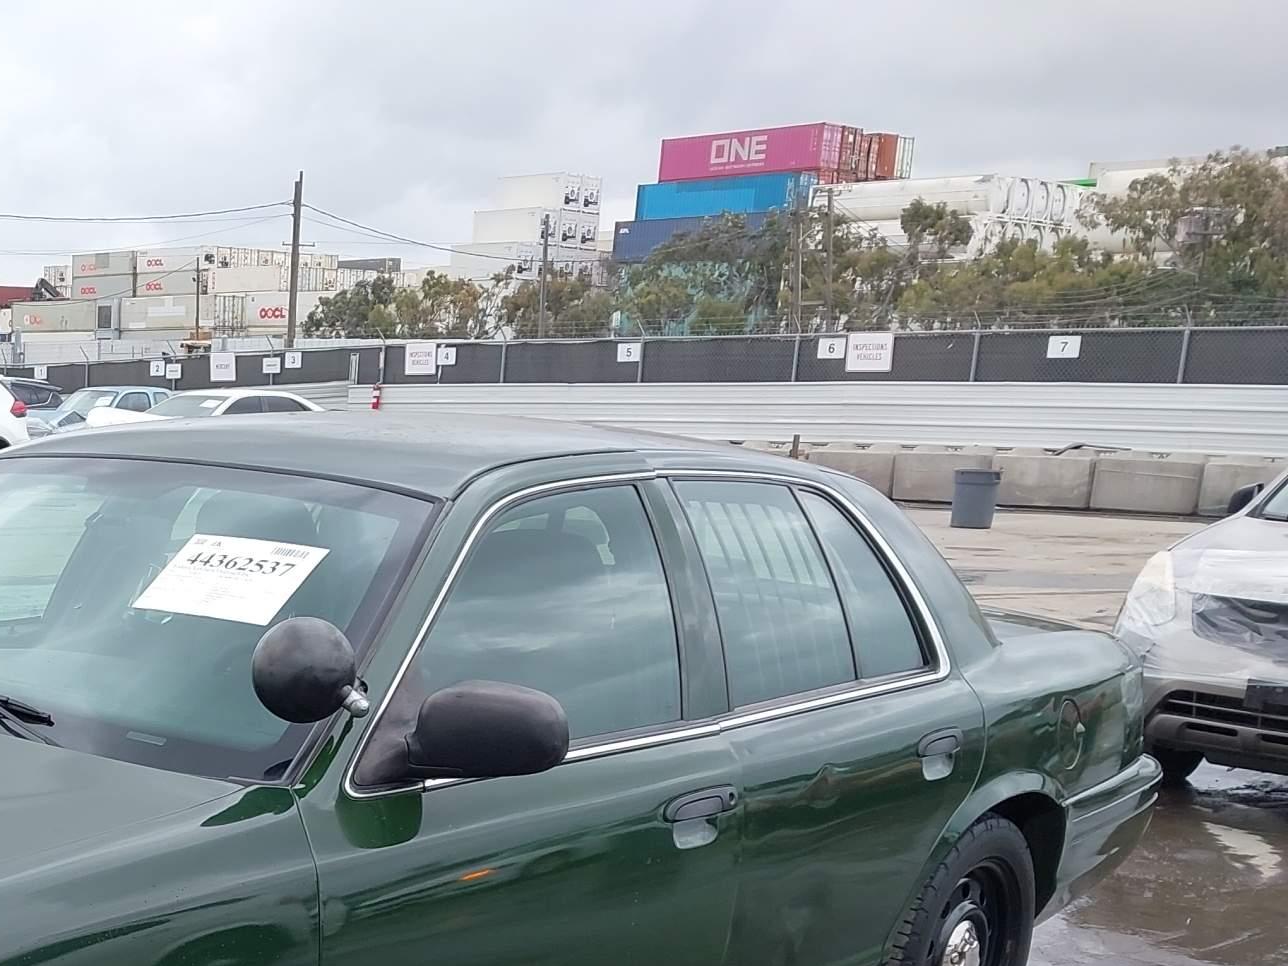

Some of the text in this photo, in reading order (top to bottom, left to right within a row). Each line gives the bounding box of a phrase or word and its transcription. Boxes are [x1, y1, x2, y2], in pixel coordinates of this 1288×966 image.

[710, 135, 768, 164] ONE
[259, 307, 287, 318] OOCL
[626, 347, 632, 357] 5
[828, 343, 835, 354] 6
[1060, 341, 1069, 353] 7
[291, 355, 296, 364] 3
[443, 352, 449, 361] 4
[155, 365, 160, 373] 2
[186, 551, 296, 577] 44362537
